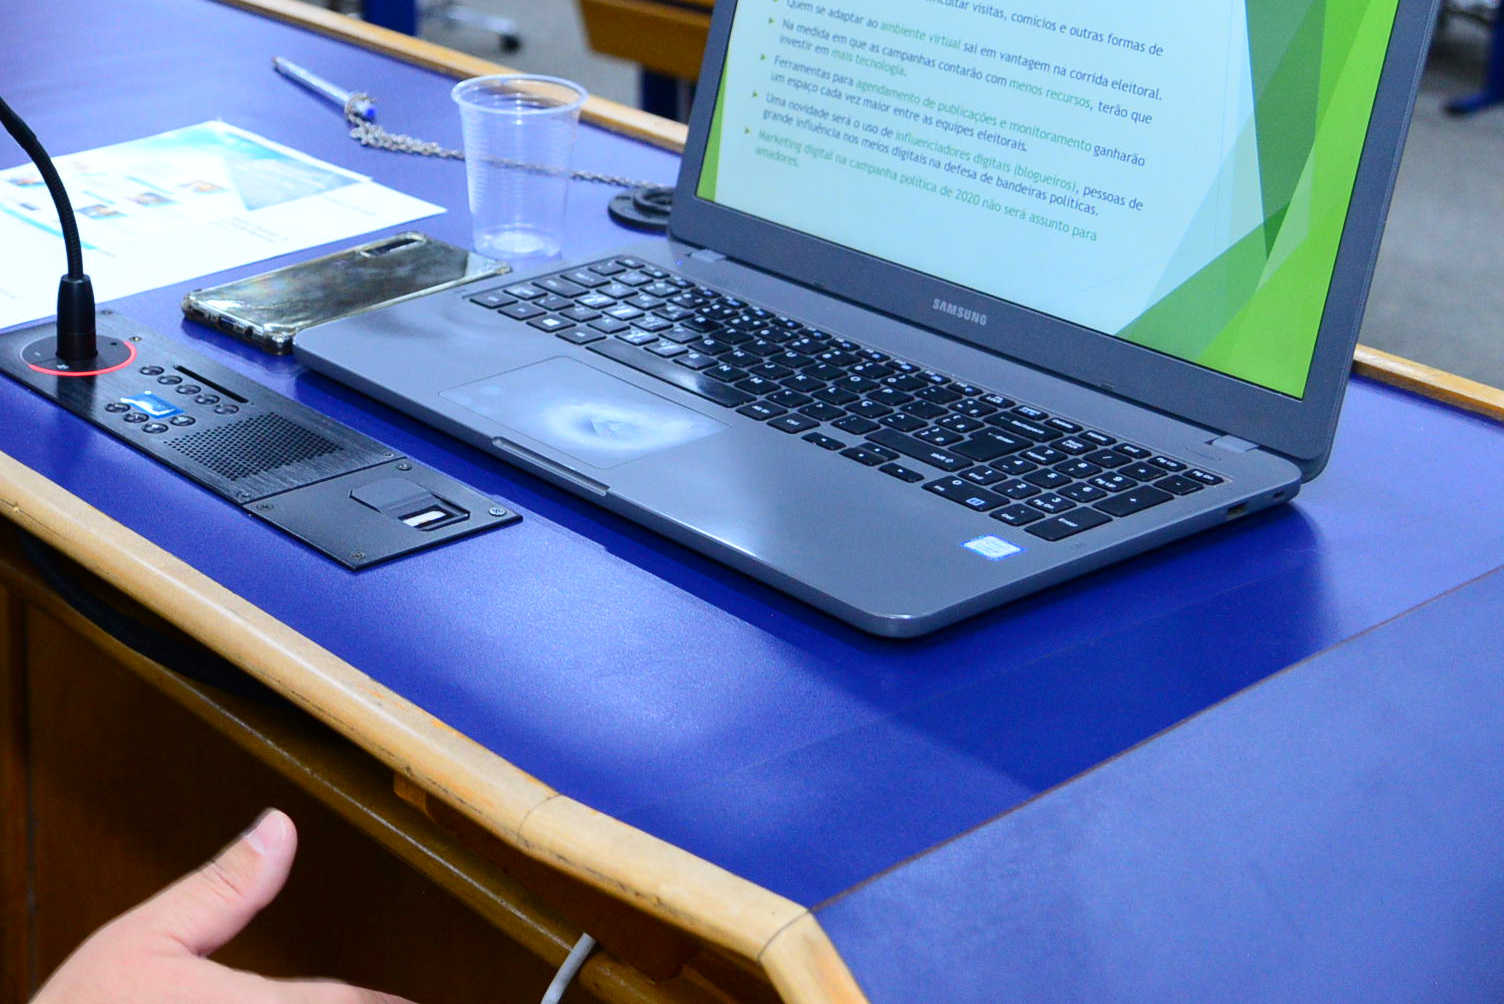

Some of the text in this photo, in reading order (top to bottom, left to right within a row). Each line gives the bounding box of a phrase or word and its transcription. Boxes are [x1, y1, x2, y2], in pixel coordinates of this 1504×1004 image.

[779, 35, 812, 50] investir
[814, 45, 829, 54] em
[831, 49, 852, 62] mais
[795, 24, 829, 40] medida
[831, 33, 846, 43] em
[848, 37, 867, 49] que
[869, 43, 879, 52] as
[881, 46, 935, 68] campanhas
[937, 60, 983, 80] contarão
[984, 73, 1007, 86] com
[1008, 79, 1042, 95] menos
[1045, 88, 1093, 111] recursos,
[1097, 100, 1128, 117] terão
[1130, 111, 1152, 124] que
[828, 8, 863, 24] adaptar
[865, 19, 878, 28] ao
[879, 22, 926, 40] ambiente
[928, 33, 961, 49] virtual
[963, 42, 977, 53] sai
[979, 47, 996, 58] em
[999, 51, 1050, 72] vantagem
[1053, 65, 1066, 76] na
[1069, 69, 1108, 87] corrida
[1110, 79, 1161, 100] eleitoral.
[972, 3, 1006, 20] visitas,
[1010, 12, 1056, 31] comícios
[1059, 24, 1067, 33] e
[1069, 26, 1104, 42] outras
[1107, 32, 1145, 52] formas
[1148, 43, 1163, 56] de
[765, 92, 1143, 211] Uma novidade será o uso de influenciadores digitais (blogueiros), pessoas de
[773, 54, 1145, 166] Ferramentas para agendamento de publicações e monitoramento ganharão
[786, 77, 818, 92] espaço
[819, 86, 842, 99] cada
[844, 93, 861, 105] vez
[862, 98, 890, 112] maior
[892, 107, 920, 121] entre
[922, 115, 932, 124] as
[935, 118, 974, 137] equipes
[976, 129, 1027, 151] eleitorais.
[762, 108, 1098, 216] grande influência nos meios digitais na defesa de bandeiras políticas.
[803, 144, 833, 160] digital
[834, 155, 847, 164] na
[848, 159, 897, 180] campanha
[899, 174, 937, 192] política
[939, 185, 953, 196] de
[954, 188, 980, 205] 2020
[981, 198, 1001, 212] não
[1003, 205, 1026, 220] será
[1028, 213, 1070, 232] assunto
[1071, 226, 1097, 241] para
[932, 298, 988, 326] SAMSUNG
